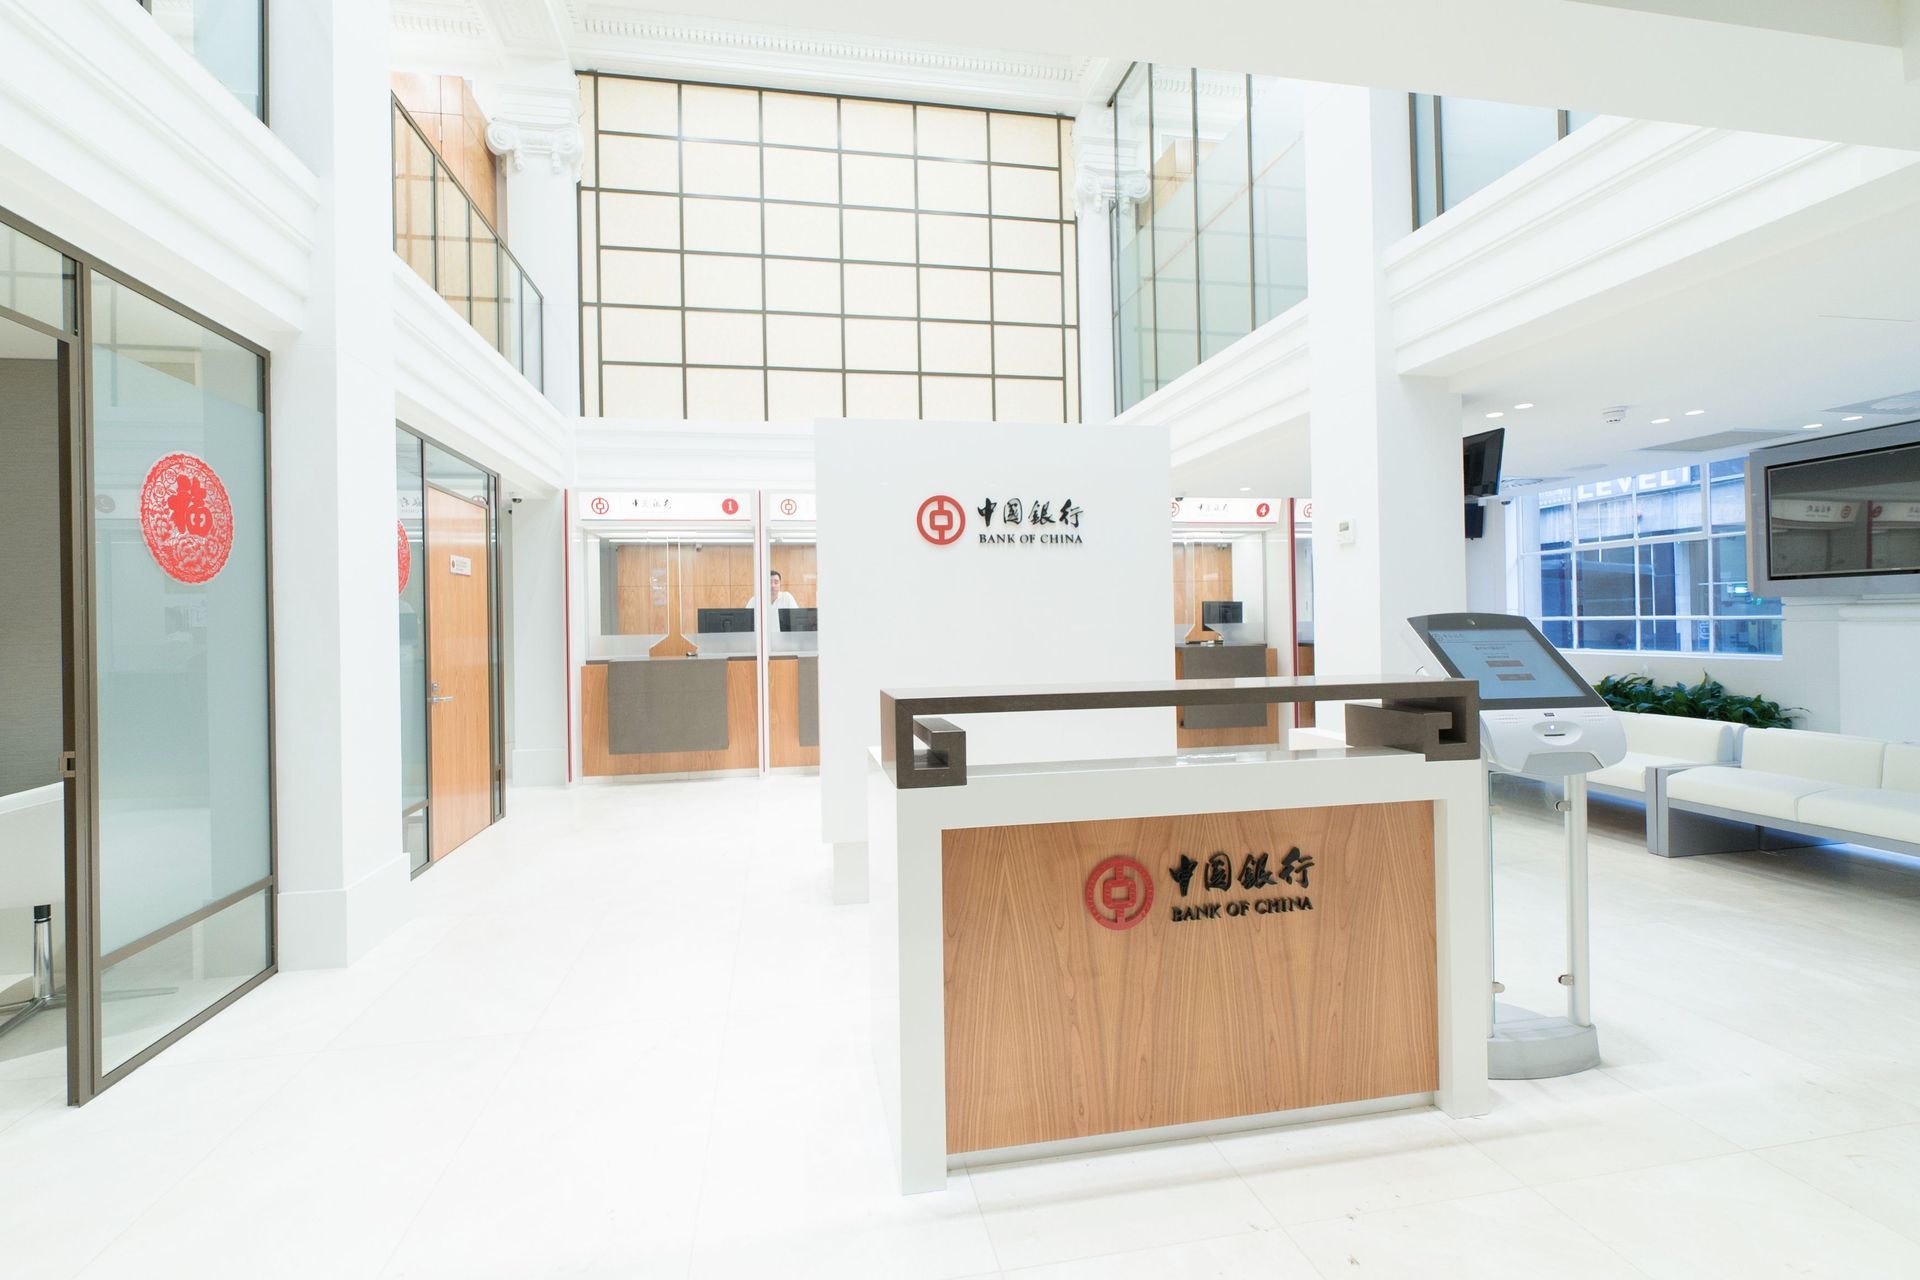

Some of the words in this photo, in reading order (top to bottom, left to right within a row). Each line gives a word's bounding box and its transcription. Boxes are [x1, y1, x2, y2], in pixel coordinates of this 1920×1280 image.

[979, 534, 1015, 544] BANK
[1020, 534, 1035, 544] OF
[1040, 534, 1083, 544] CHINA
[1172, 905, 1221, 922] BANK
[1226, 900, 1250, 917] OF
[1255, 897, 1313, 915] CHINA
